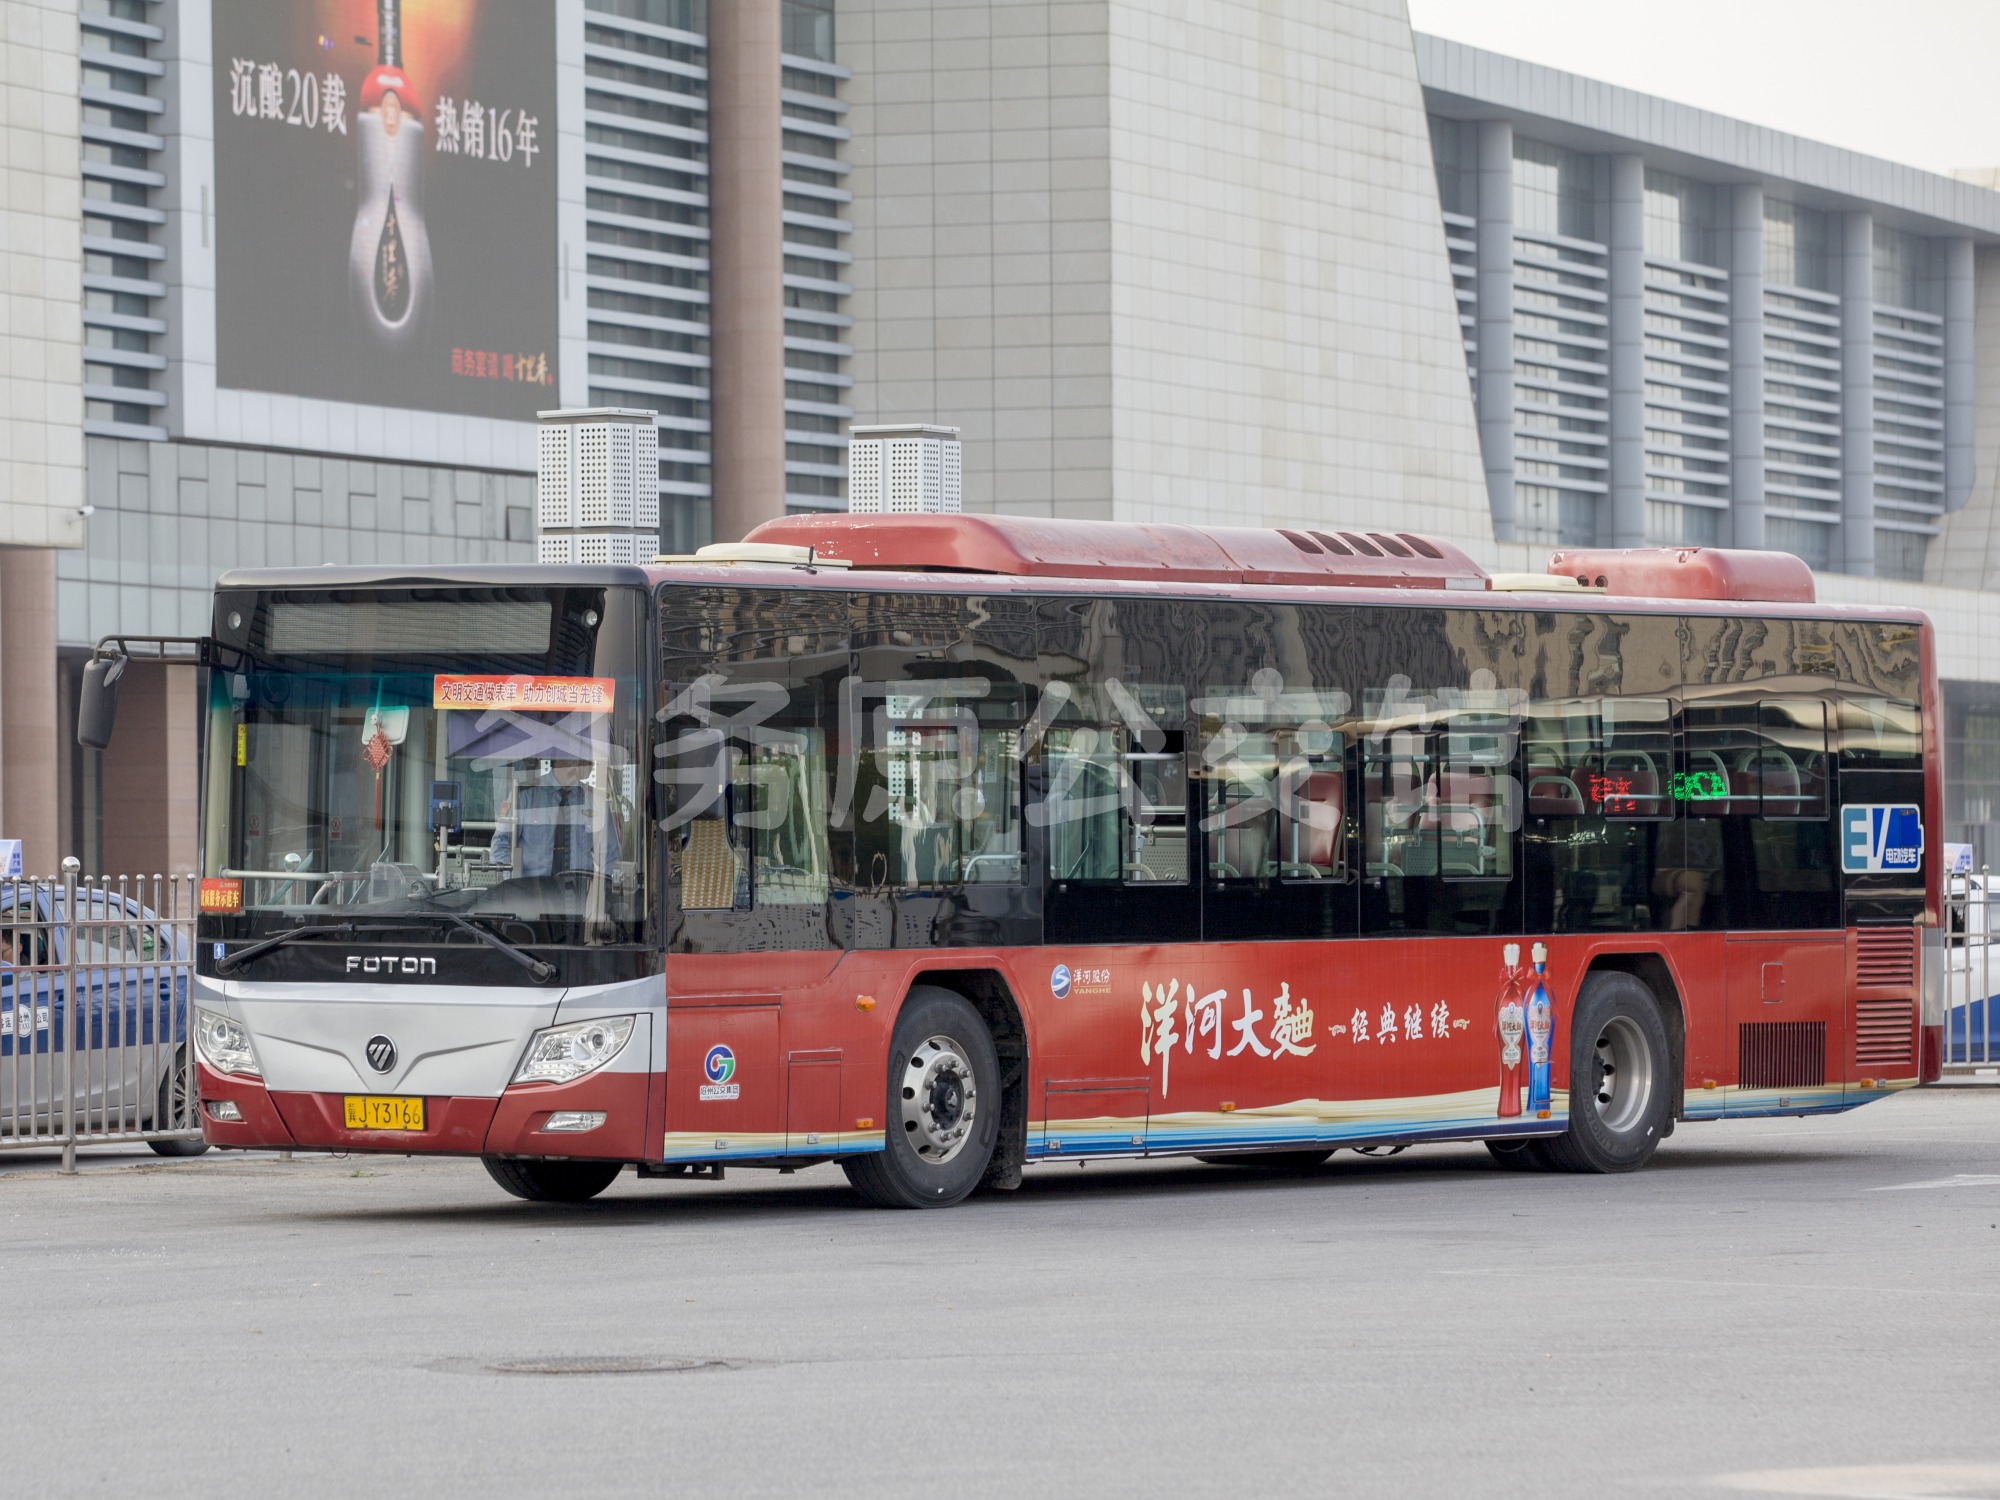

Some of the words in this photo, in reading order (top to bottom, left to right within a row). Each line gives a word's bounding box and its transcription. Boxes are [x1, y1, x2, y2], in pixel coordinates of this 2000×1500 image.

[230, 57, 347, 136] 沉酿20载
[435, 95, 540, 168] 热销16年
[441, 681, 517, 702] 文明交通做表率
[523, 683, 604, 704] 助力创城当先锋
[1885, 847, 1917, 864] 电动汽车
[346, 956, 436, 974] FOTON
[1073, 968, 1111, 986] 洋河股份
[1073, 987, 1112, 995] YANGHE
[1350, 999, 1451, 1046] 经典继续
